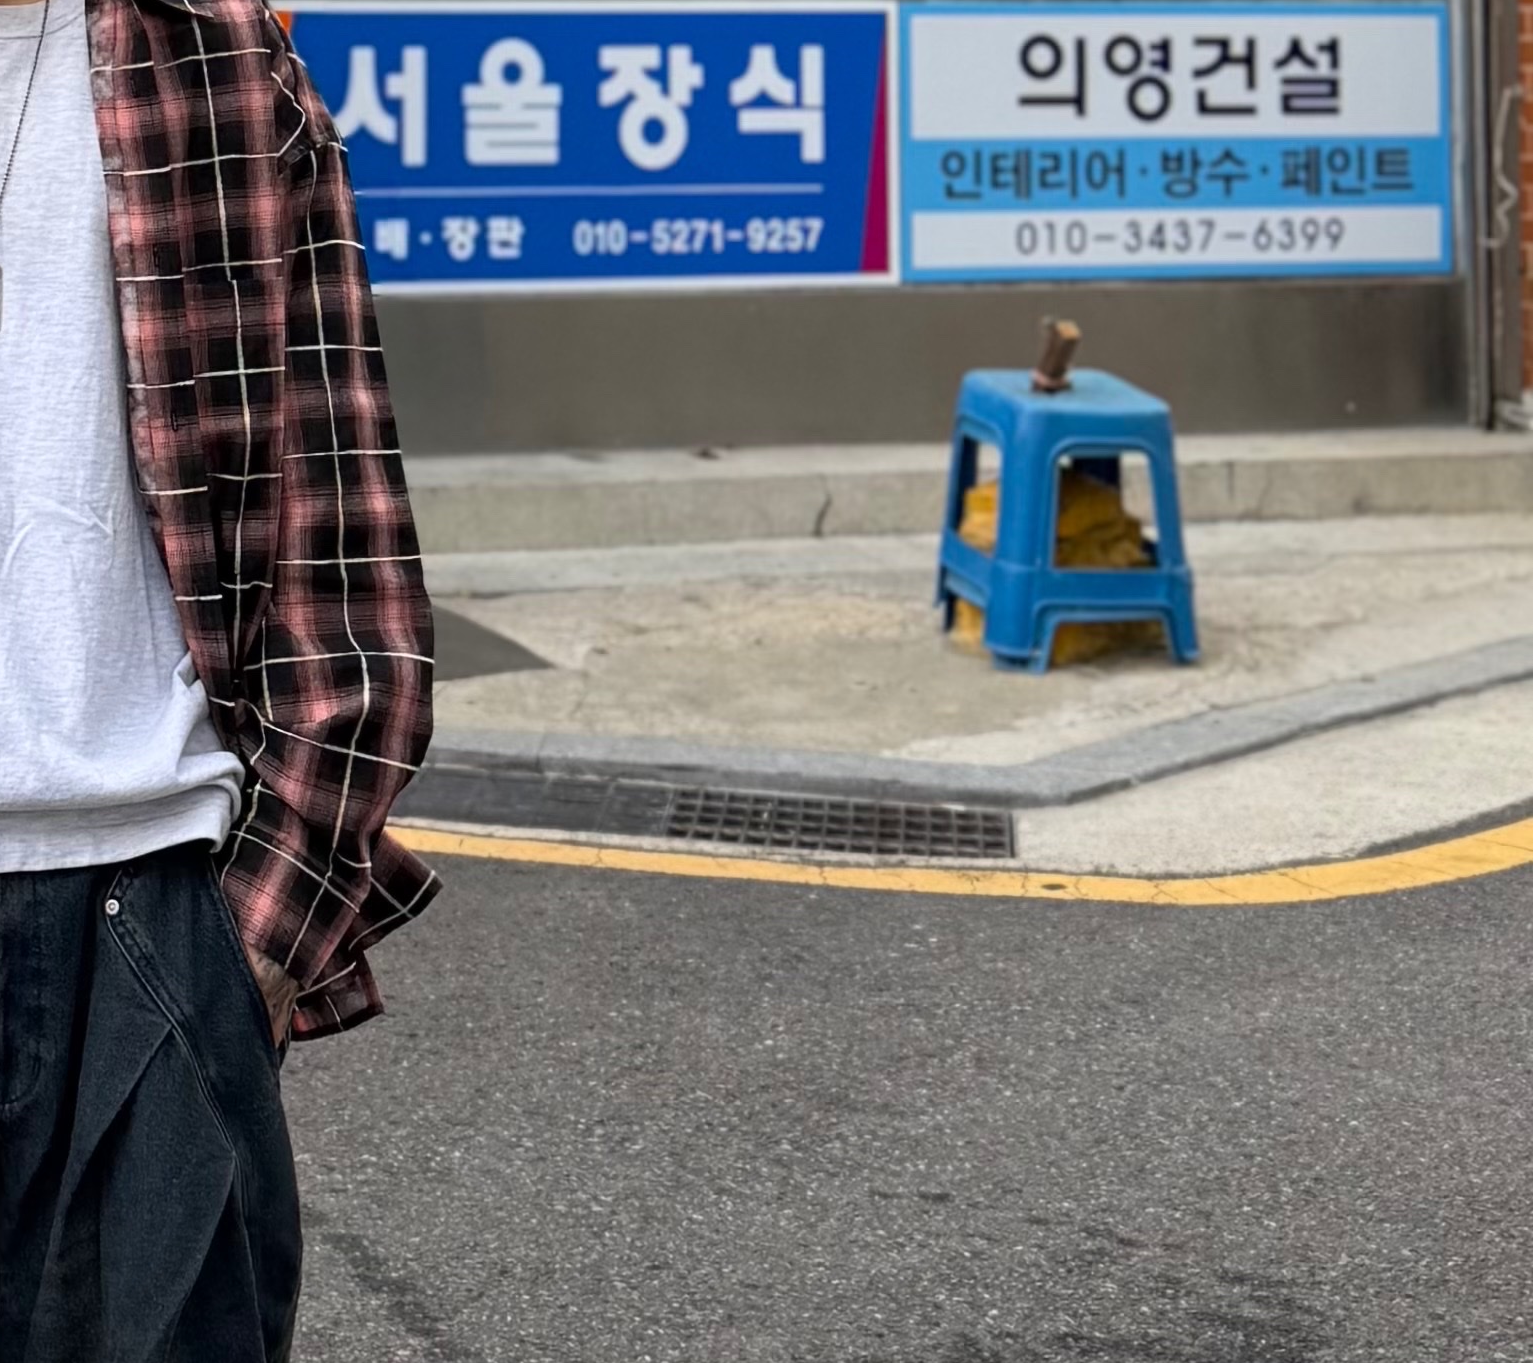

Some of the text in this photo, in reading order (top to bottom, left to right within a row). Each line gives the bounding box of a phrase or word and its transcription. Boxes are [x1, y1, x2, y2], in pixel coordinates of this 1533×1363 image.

[1016, 33, 1342, 122] 의영건설
[572, 218, 824, 256] 010-5271-9257
[1015, 218, 1346, 257] 010-3437-6399
